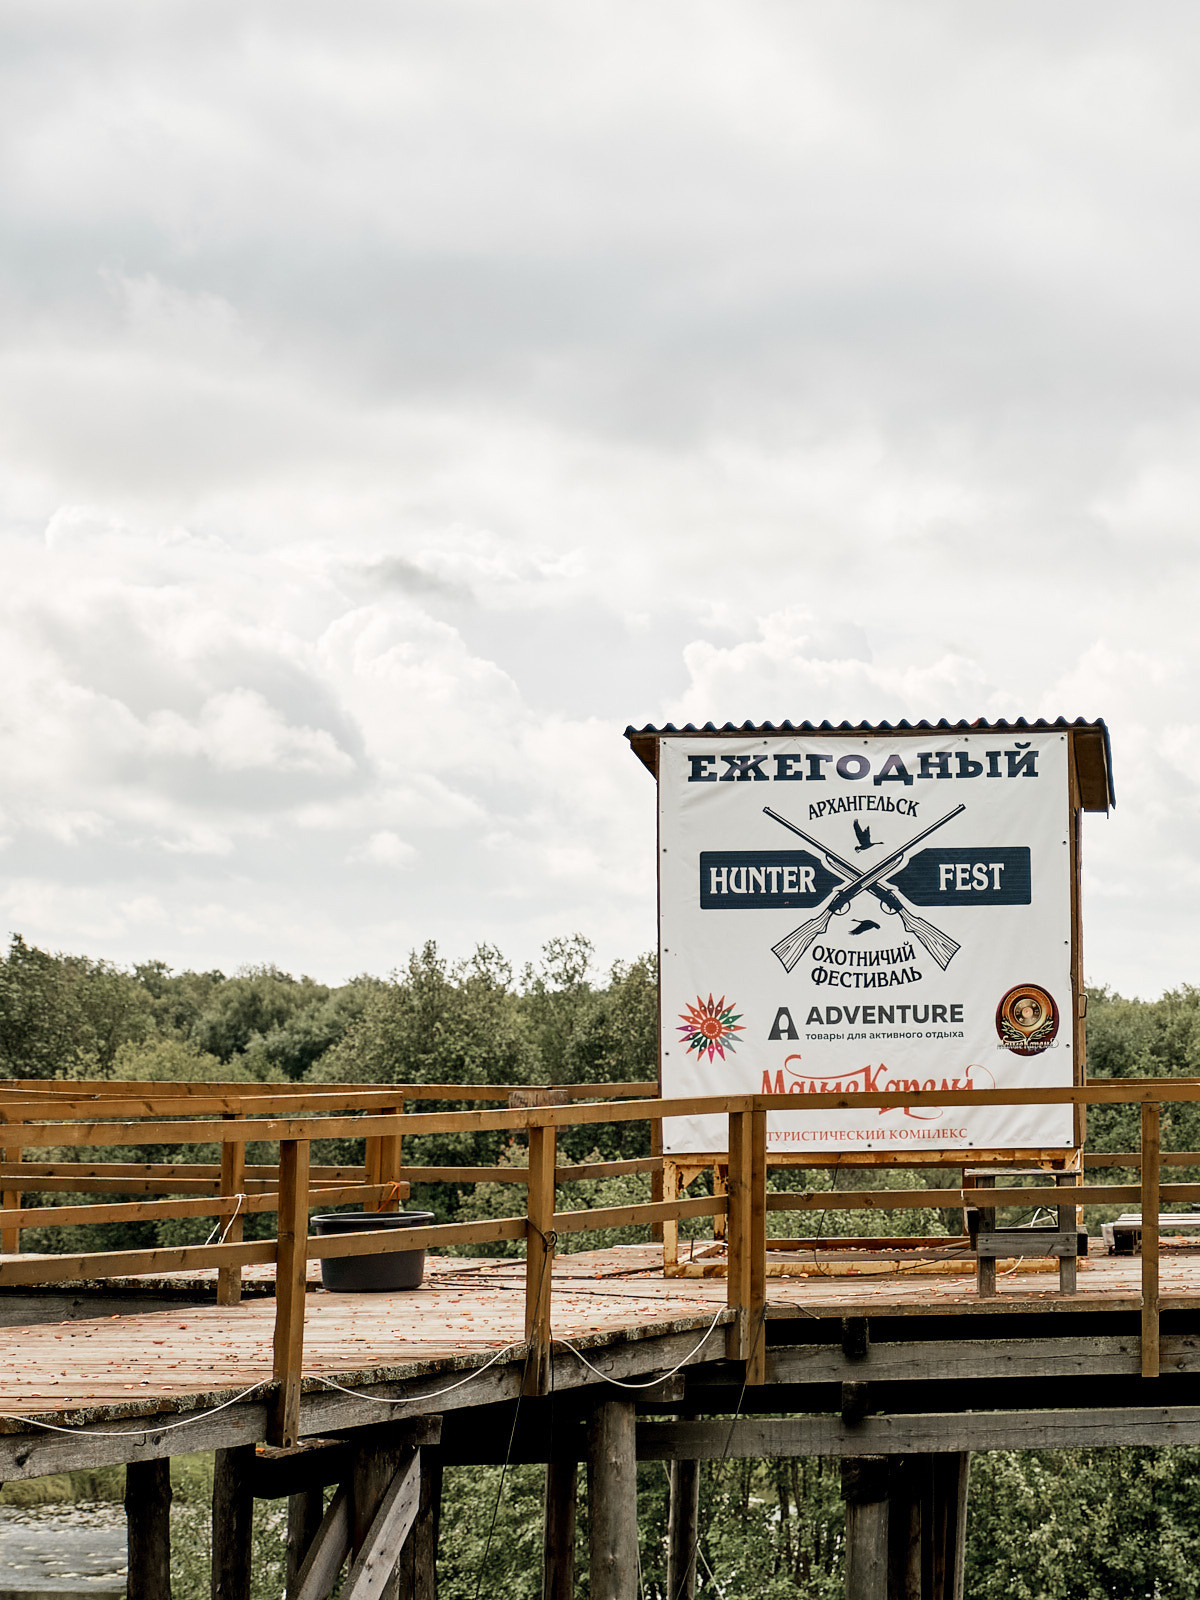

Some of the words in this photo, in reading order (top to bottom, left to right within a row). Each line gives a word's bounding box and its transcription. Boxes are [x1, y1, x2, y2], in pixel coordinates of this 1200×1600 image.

[687, 742, 1040, 787] ЕЖЕГОДНЫЙ
[808, 795, 920, 820] АРХАНГЕЛЬСК
[709, 866, 817, 894] HUNTER
[938, 862, 1005, 891] FEST
[811, 941, 917, 966] ОХОТНИЧИЙ
[810, 966, 923, 988] ФЕСТИВАЛЬ
[805, 1003, 964, 1026] ADVENTURE
[805, 1033, 845, 1042] товары
[847, 1032, 867, 1041] для
[869, 1031, 923, 1040] активного
[925, 1030, 965, 1040] отдыха
[766, 1127, 886, 1142] ТУРИСТИЧЕСКИЙ
[889, 1127, 968, 1140] КОМПЛЕКС
